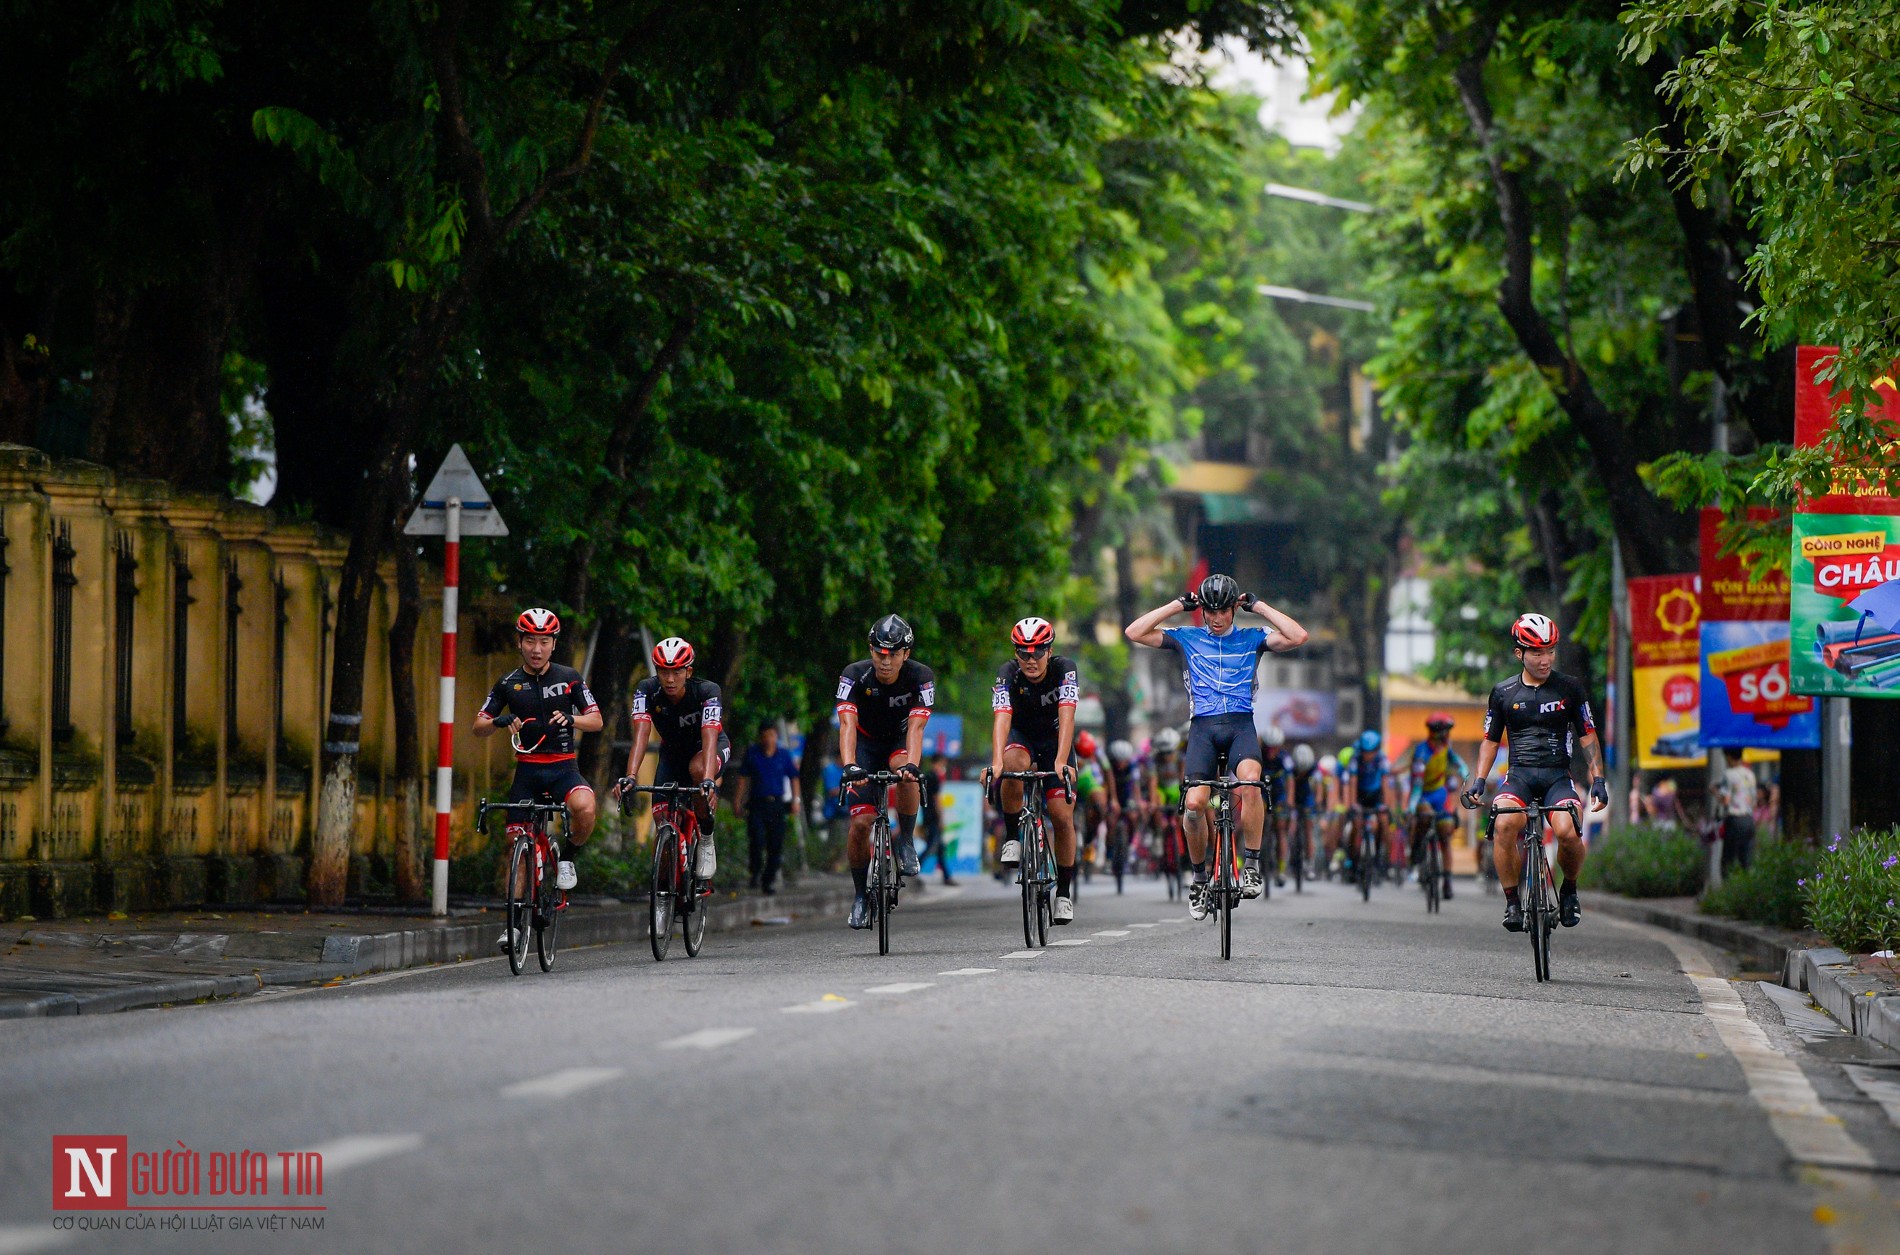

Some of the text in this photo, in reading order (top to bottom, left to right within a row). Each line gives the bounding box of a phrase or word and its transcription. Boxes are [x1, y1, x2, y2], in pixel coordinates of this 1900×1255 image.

[1804, 535, 1881, 551] CÔNG NGHỆ
[1818, 555, 1900, 587] CHÂU
[1739, 663, 1787, 703] SỐ
[704, 707, 716, 721] 84
[1540, 699, 1566, 714] KTX
